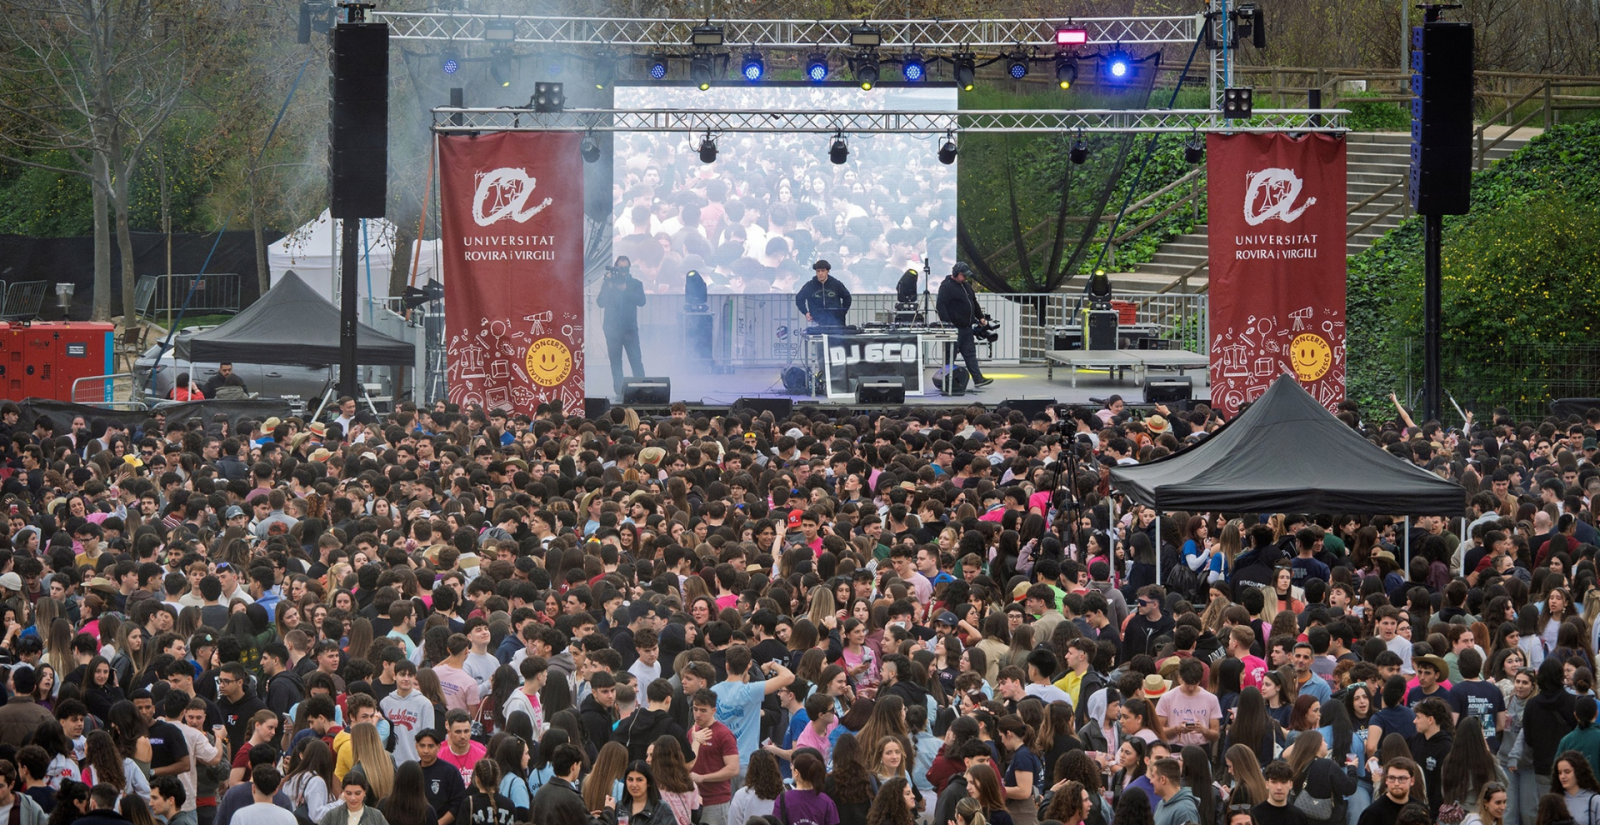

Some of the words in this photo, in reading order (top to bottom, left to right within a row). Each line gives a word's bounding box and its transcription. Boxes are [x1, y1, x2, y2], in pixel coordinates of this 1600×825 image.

[463, 235, 555, 246] UNIVERSITAT
[1235, 234, 1318, 245] UNIVERSITAT
[464, 250, 507, 261] ROVIRA
[514, 250, 555, 261] VIRGILI
[1236, 249, 1275, 260] ROVIRA
[1282, 248, 1317, 259] VIRGILI
[531, 339, 568, 354] CONCERTS
[1292, 335, 1327, 350] CONCERTS
[830, 344, 860, 366] DJ
[527, 354, 553, 385] ACTIVITATS
[555, 357, 571, 383] GRESCA
[1314, 352, 1330, 378] GRESCA
